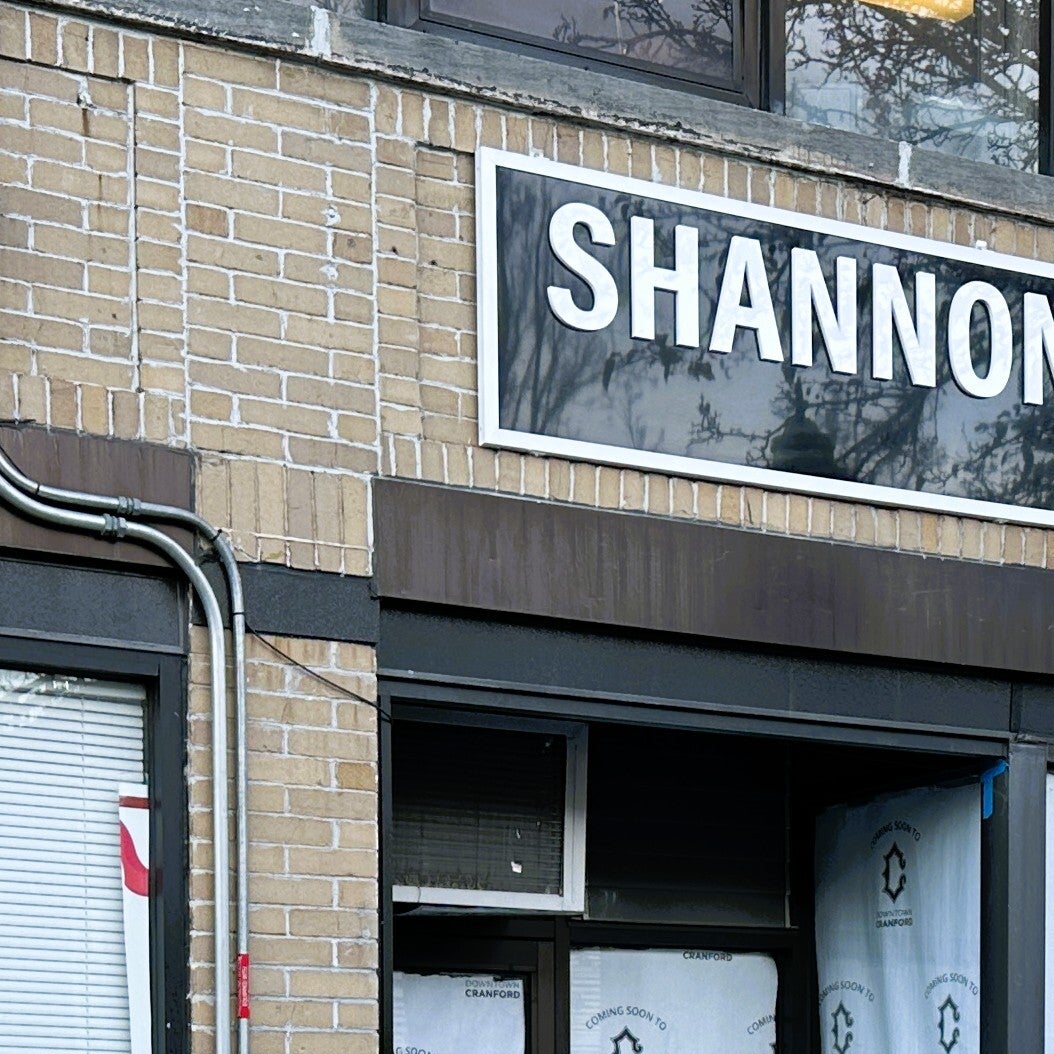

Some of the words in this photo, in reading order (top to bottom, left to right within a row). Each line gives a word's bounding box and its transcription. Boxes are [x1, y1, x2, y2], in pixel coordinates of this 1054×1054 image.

[683, 951, 732, 961] CRANFORD
[465, 989, 520, 999] CRANFORD
[585, 1006, 624, 1030] COMING
[626, 1005, 654, 1022] SOON
[654, 1017, 667, 1031] TO
